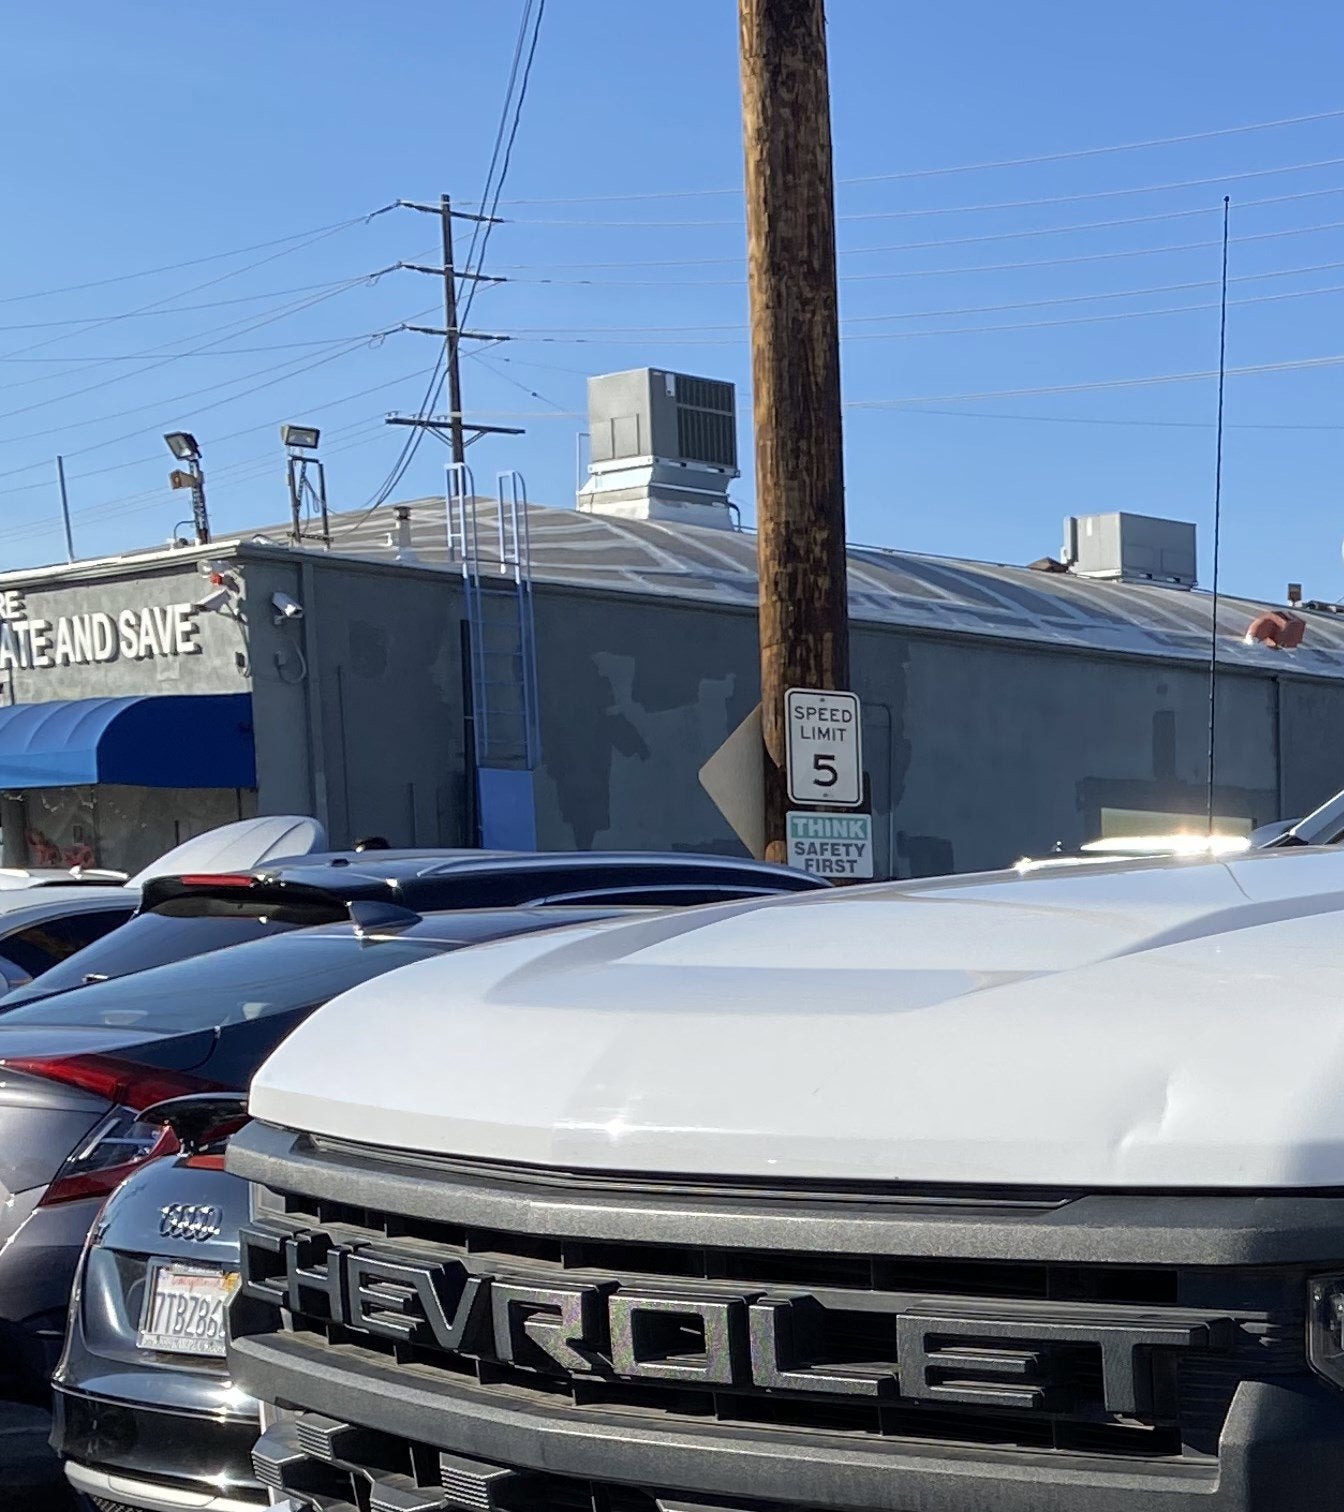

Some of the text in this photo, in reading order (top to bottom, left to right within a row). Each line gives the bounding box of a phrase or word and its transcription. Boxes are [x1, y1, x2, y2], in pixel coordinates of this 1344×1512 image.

[56, 612, 113, 664] AND
[119, 603, 195, 658] SAVE
[794, 705, 852, 724] SPEED
[800, 725, 847, 742] LIMIT
[813, 753, 838, 787] 5
[792, 818, 865, 839] THINK
[794, 841, 866, 858] SAFETY
[804, 859, 858, 874] FIRST
[154, 1291, 225, 1338] 7TBZ86
[238, 1223, 1238, 1428] CHEVROLET
